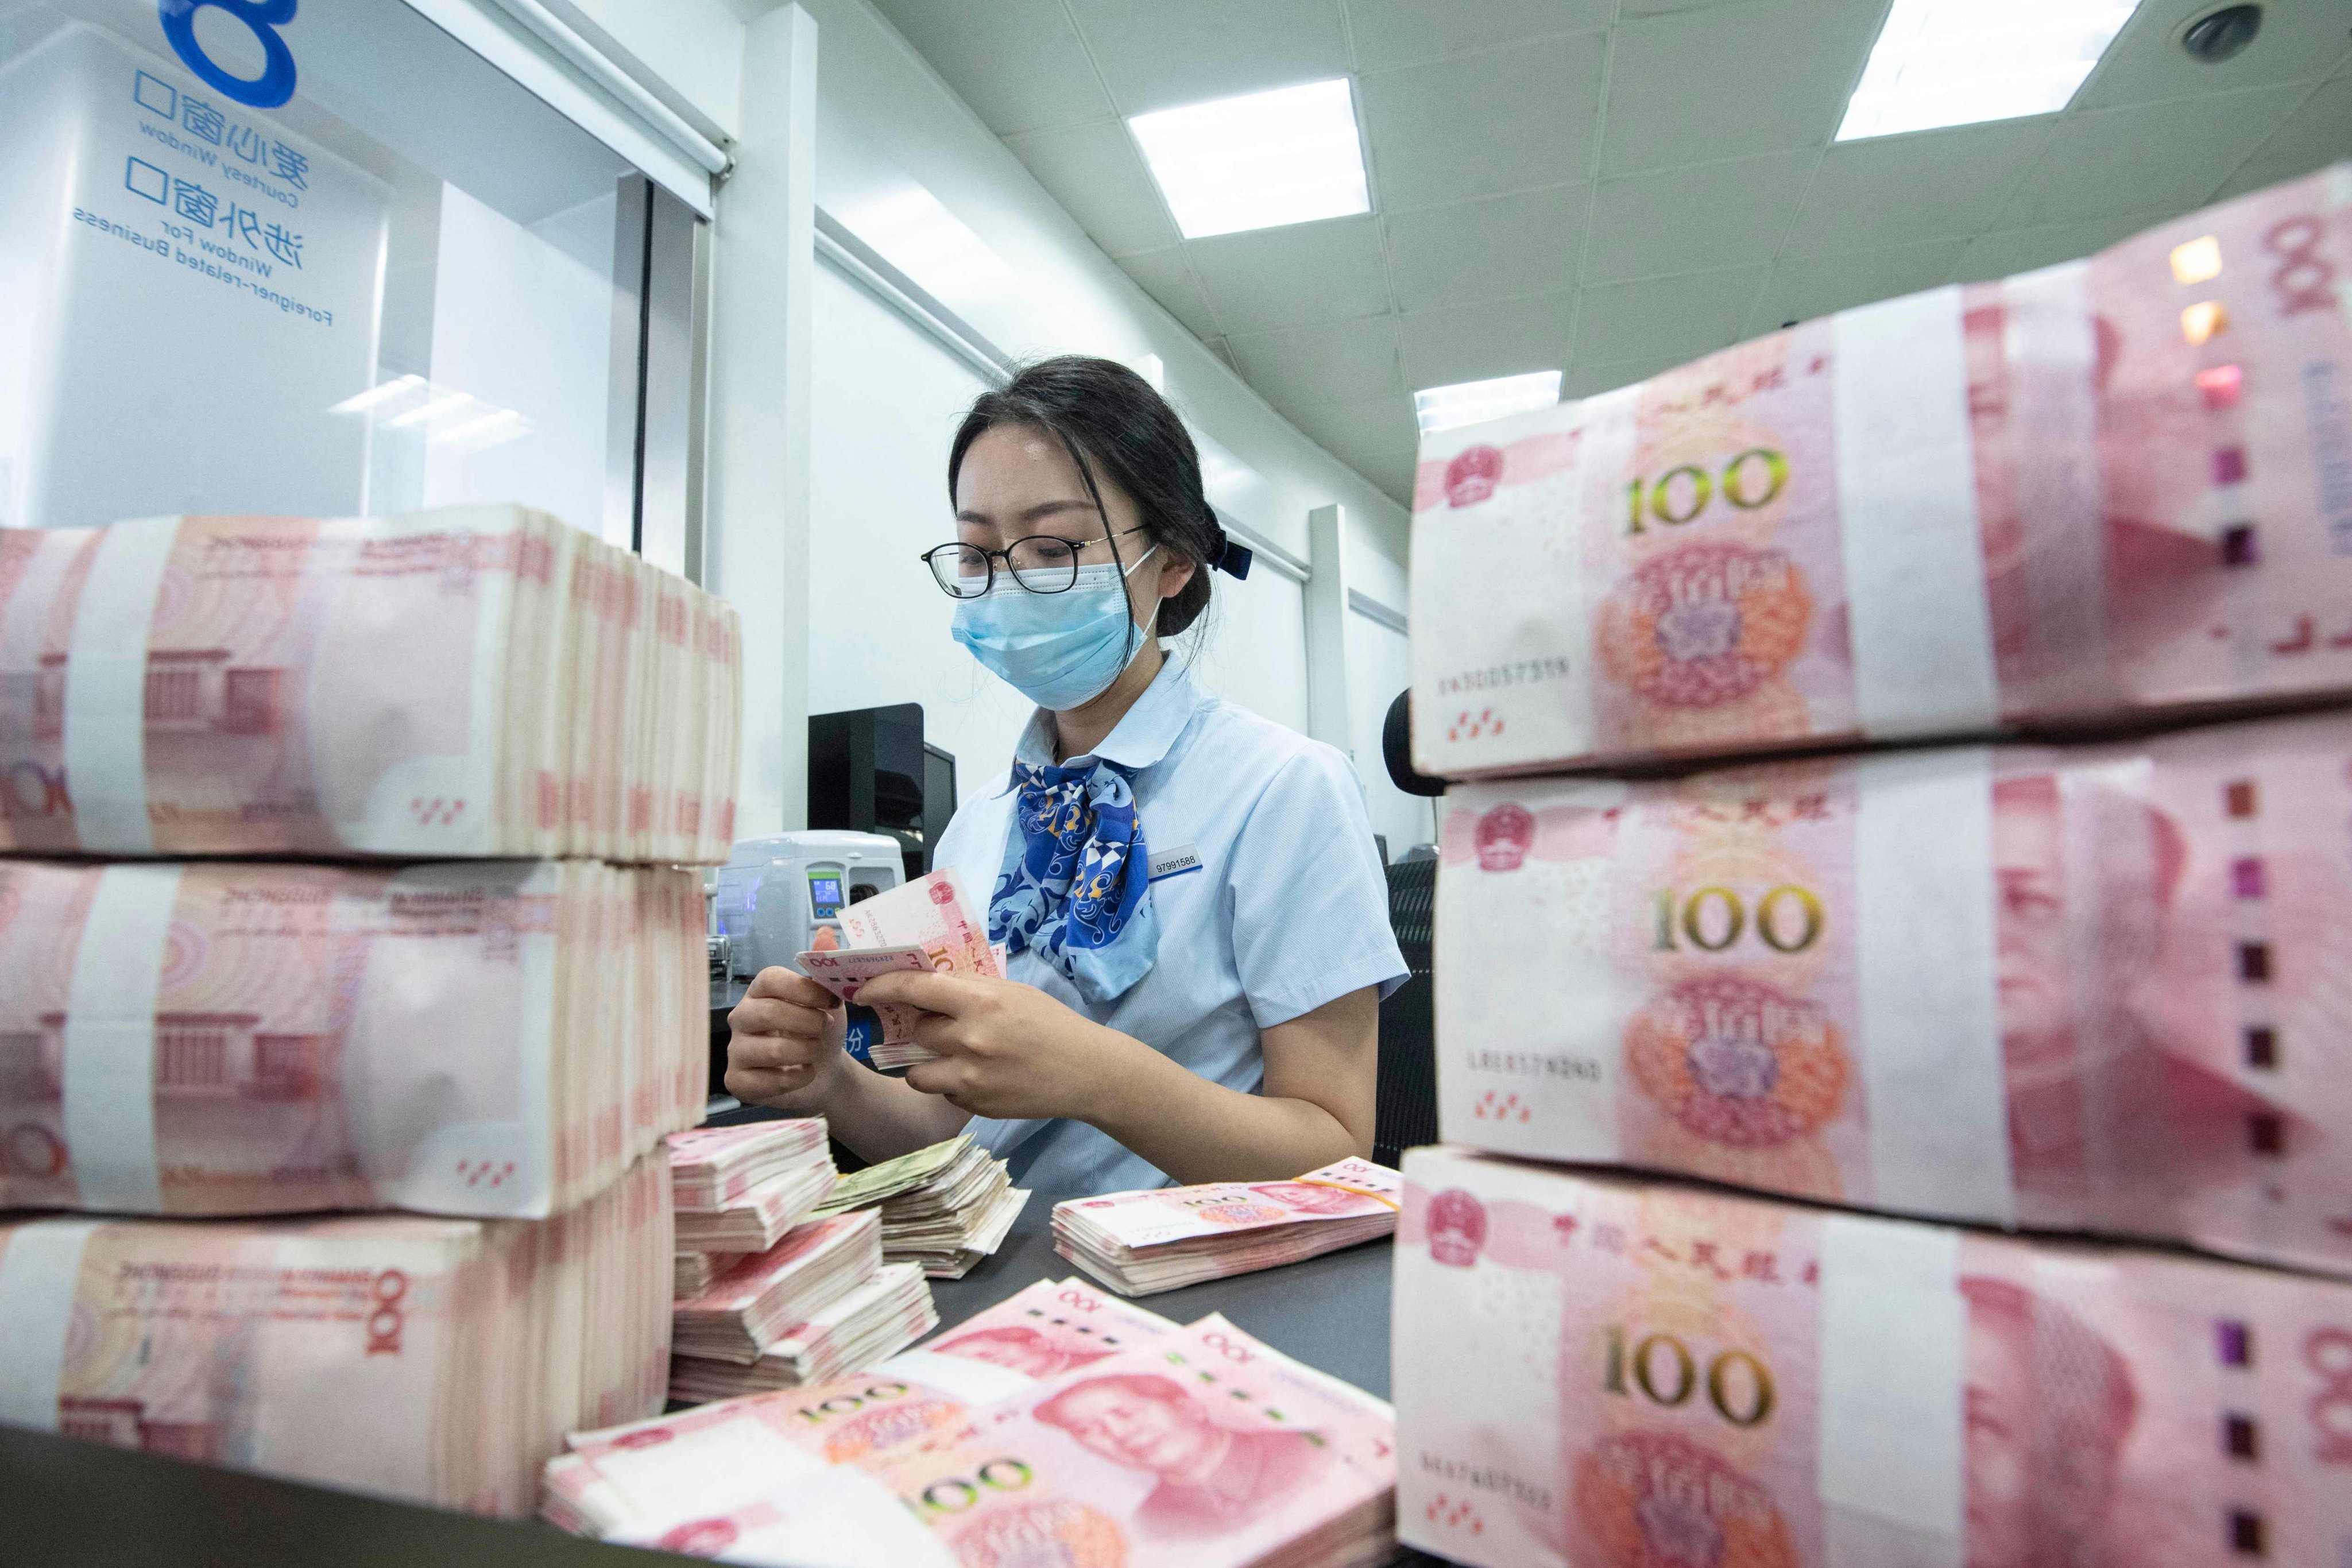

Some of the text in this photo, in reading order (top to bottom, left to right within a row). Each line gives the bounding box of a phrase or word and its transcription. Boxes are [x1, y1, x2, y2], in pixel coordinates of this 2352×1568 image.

[2265, 214, 2339, 317] 100
[1624, 447, 1790, 536] 100
[1156, 855, 1196, 873] 97991588
[1652, 884, 1827, 954] 100
[809, 957, 840, 967] 100
[367, 1268, 410, 1356] 100
[797, 1381, 908, 1424] 100
[1598, 1325, 1777, 1428] 100
